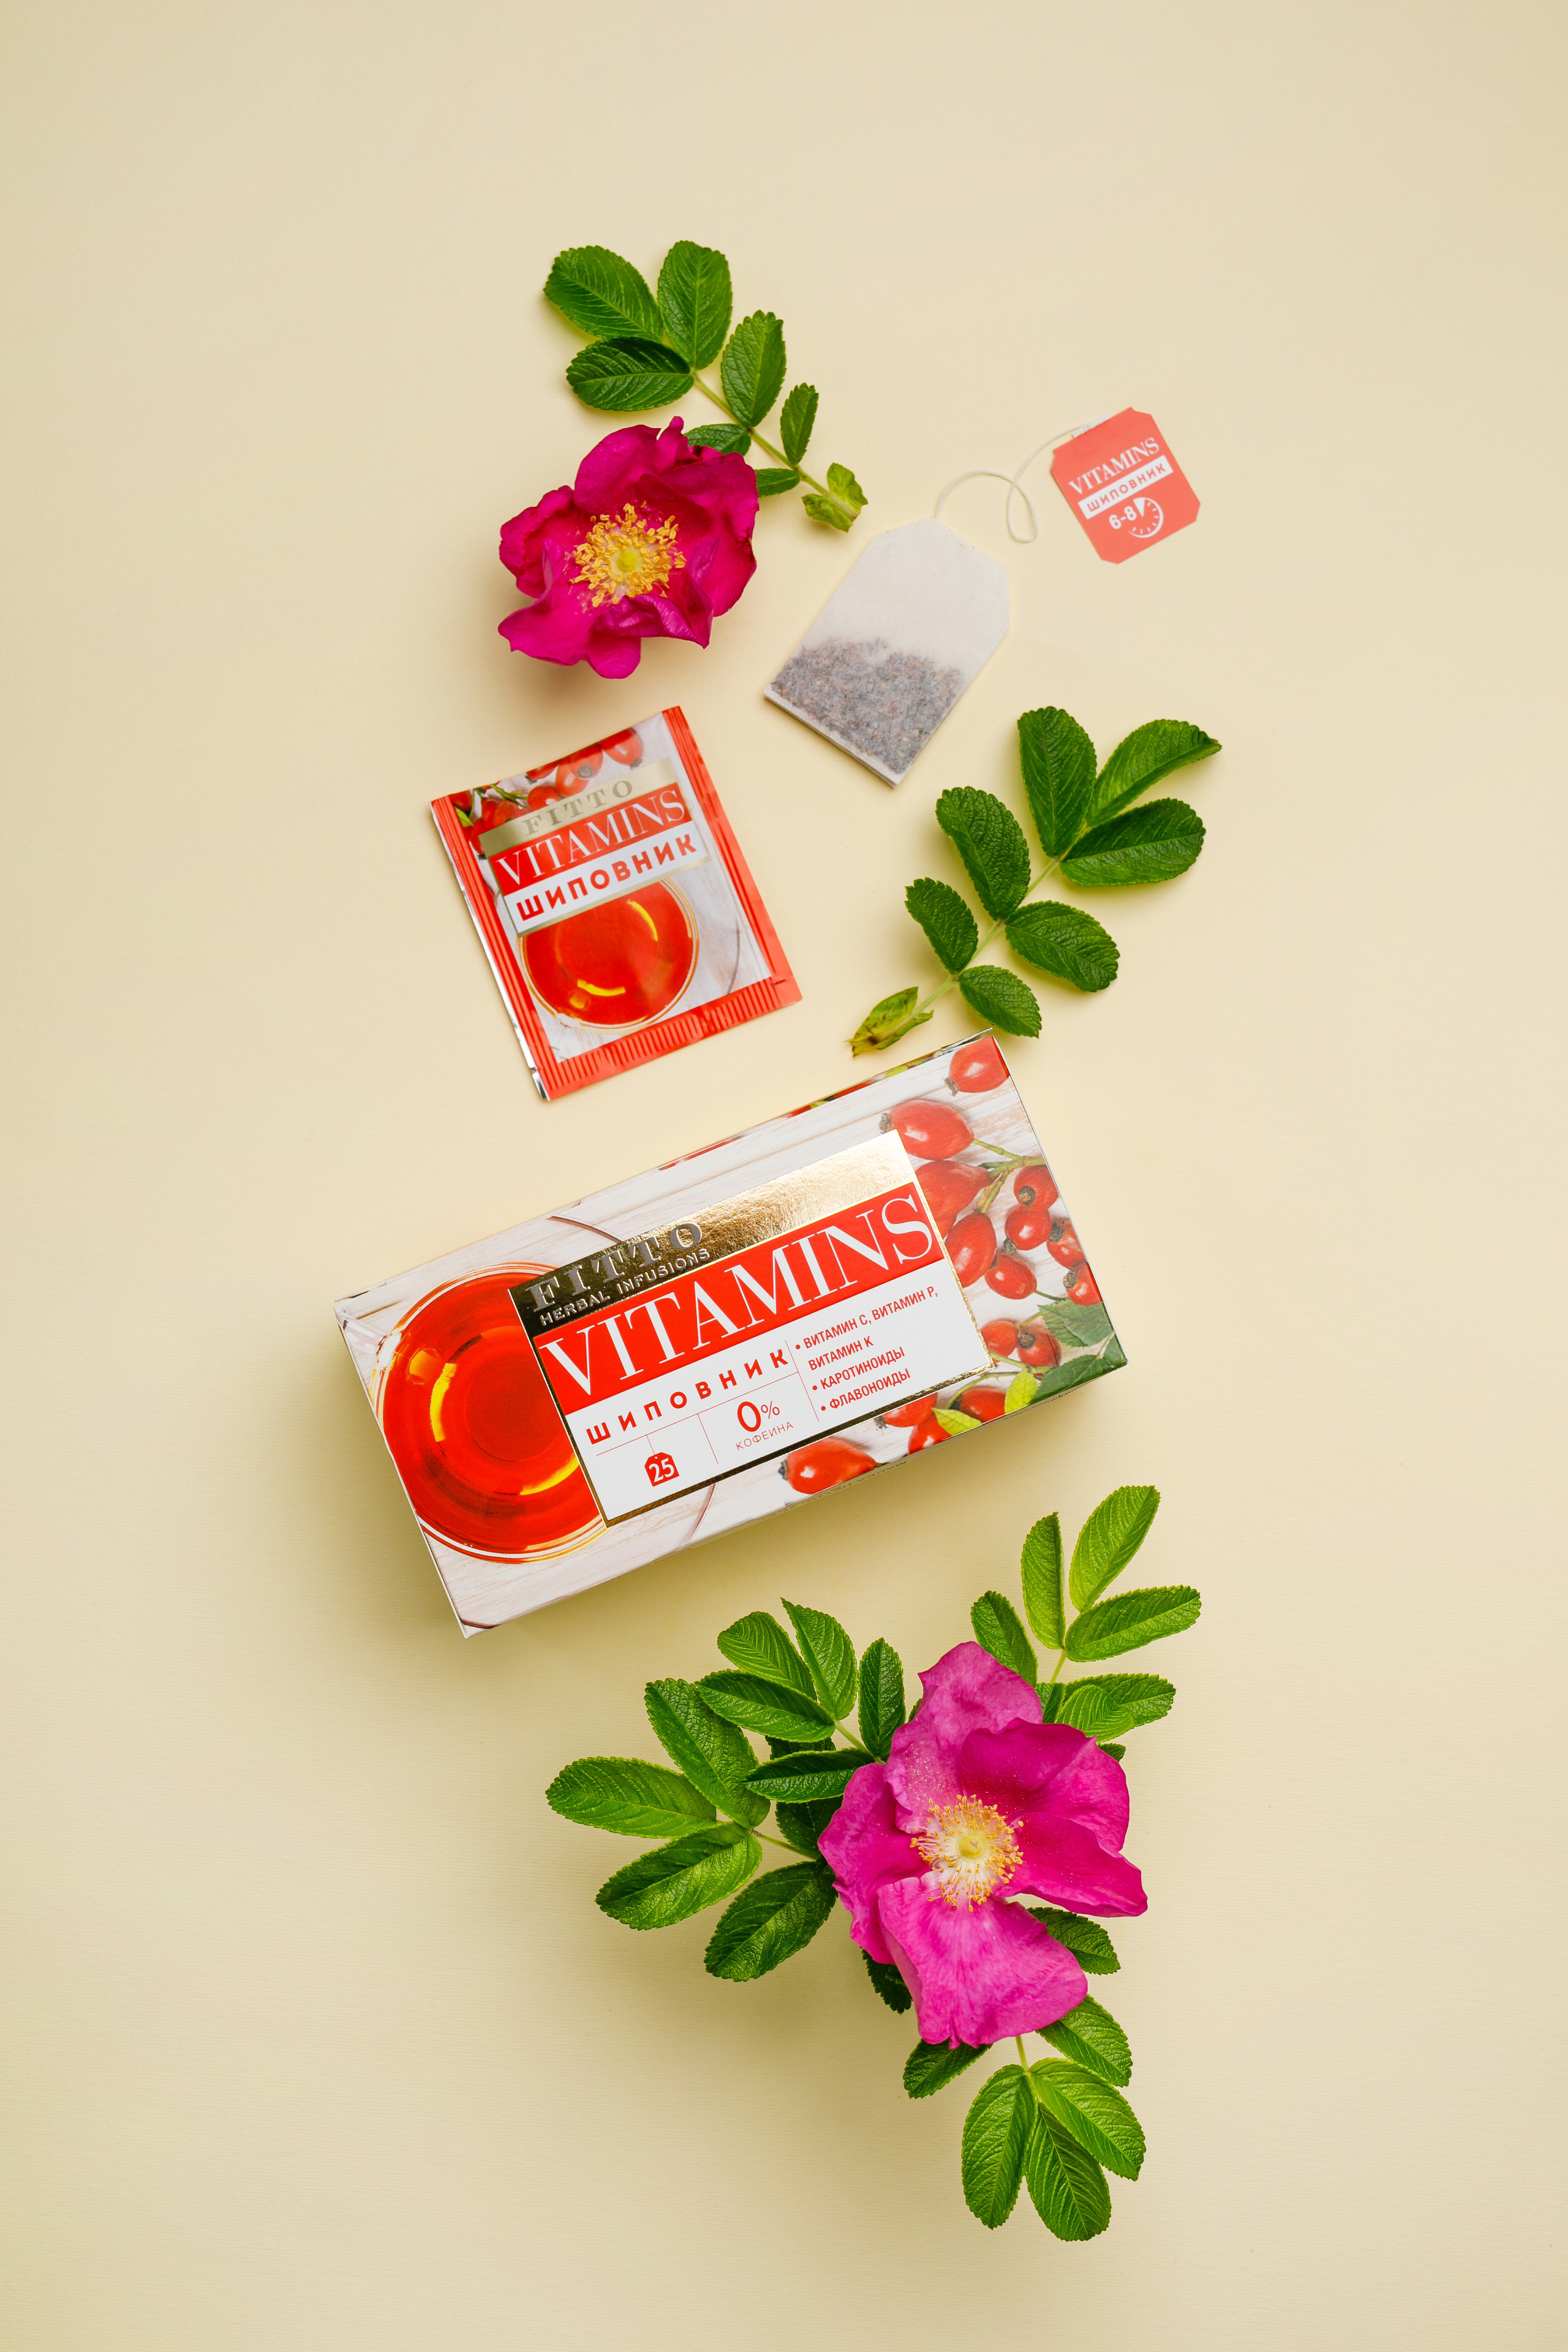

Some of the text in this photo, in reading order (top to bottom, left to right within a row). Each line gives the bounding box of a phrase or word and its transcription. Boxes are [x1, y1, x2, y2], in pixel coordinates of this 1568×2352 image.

[1068, 437, 1159, 494] VITAMINS
[1087, 463, 1166, 512] ШИПОВНИК
[1109, 506, 1137, 529] 6-8
[522, 780, 633, 837] FITTO
[496, 790, 685, 886] VITAMINS
[516, 834, 697, 921] ШИПОВНИК
[525, 1222, 703, 1312] FITTO
[539, 1194, 932, 1396] VITAMINS
[540, 1248, 710, 1326] HERBAL INFUSIONS
[803, 1318, 858, 1349] ВИТАМИН
[871, 1290, 926, 1321] ВИТАМИН
[808, 1340, 863, 1371] ВИТАМИН
[820, 1346, 905, 1390] КАРОТИНОИДЫ
[586, 1349, 789, 1445] ШИПОВНИК
[737, 1401, 780, 1432] 0%
[829, 1368, 911, 1409] ФЛАВОНОИДЫ
[735, 1421, 794, 1450] КОФЕИНА
[649, 1457, 675, 1483] 25
